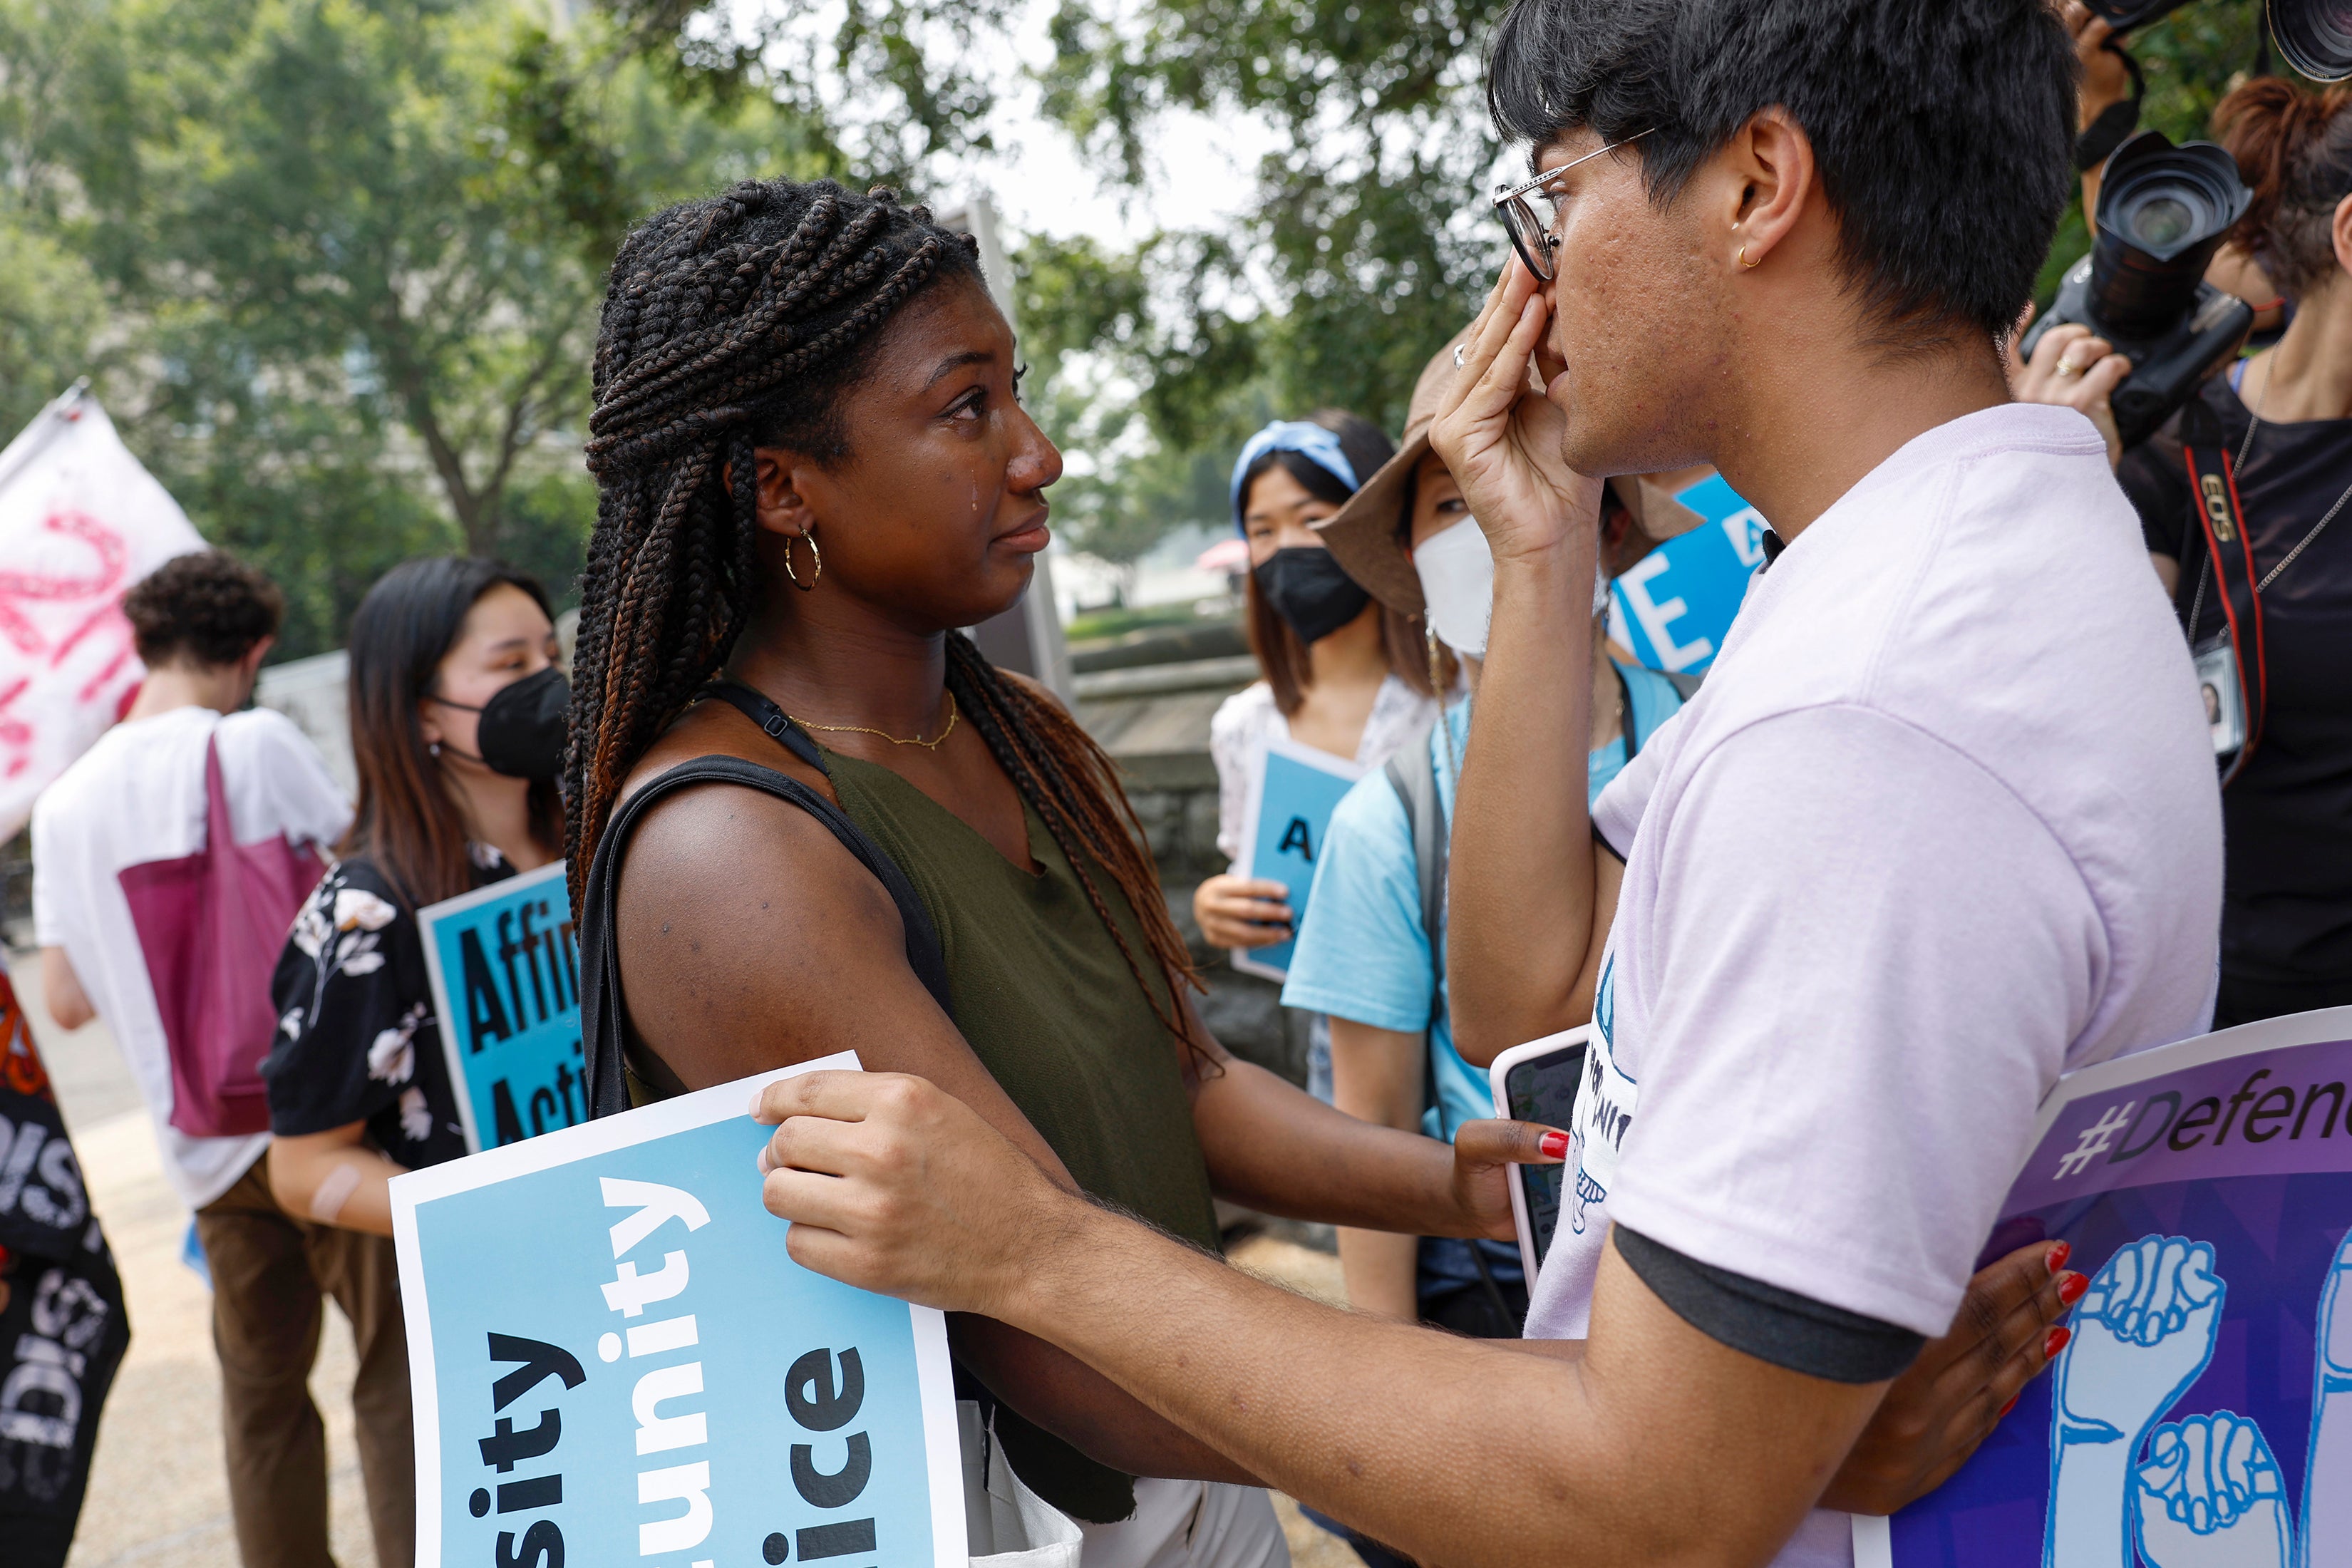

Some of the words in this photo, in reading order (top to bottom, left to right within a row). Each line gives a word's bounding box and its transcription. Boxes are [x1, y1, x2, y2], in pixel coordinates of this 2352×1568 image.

[2200, 473, 2237, 542] EOS
[1280, 818, 1313, 862] A
[2053, 1068, 2352, 1180] #Defen
[468, 1332, 587, 1568] sity
[597, 1177, 713, 1568] unity
[762, 1346, 878, 1568] ice
